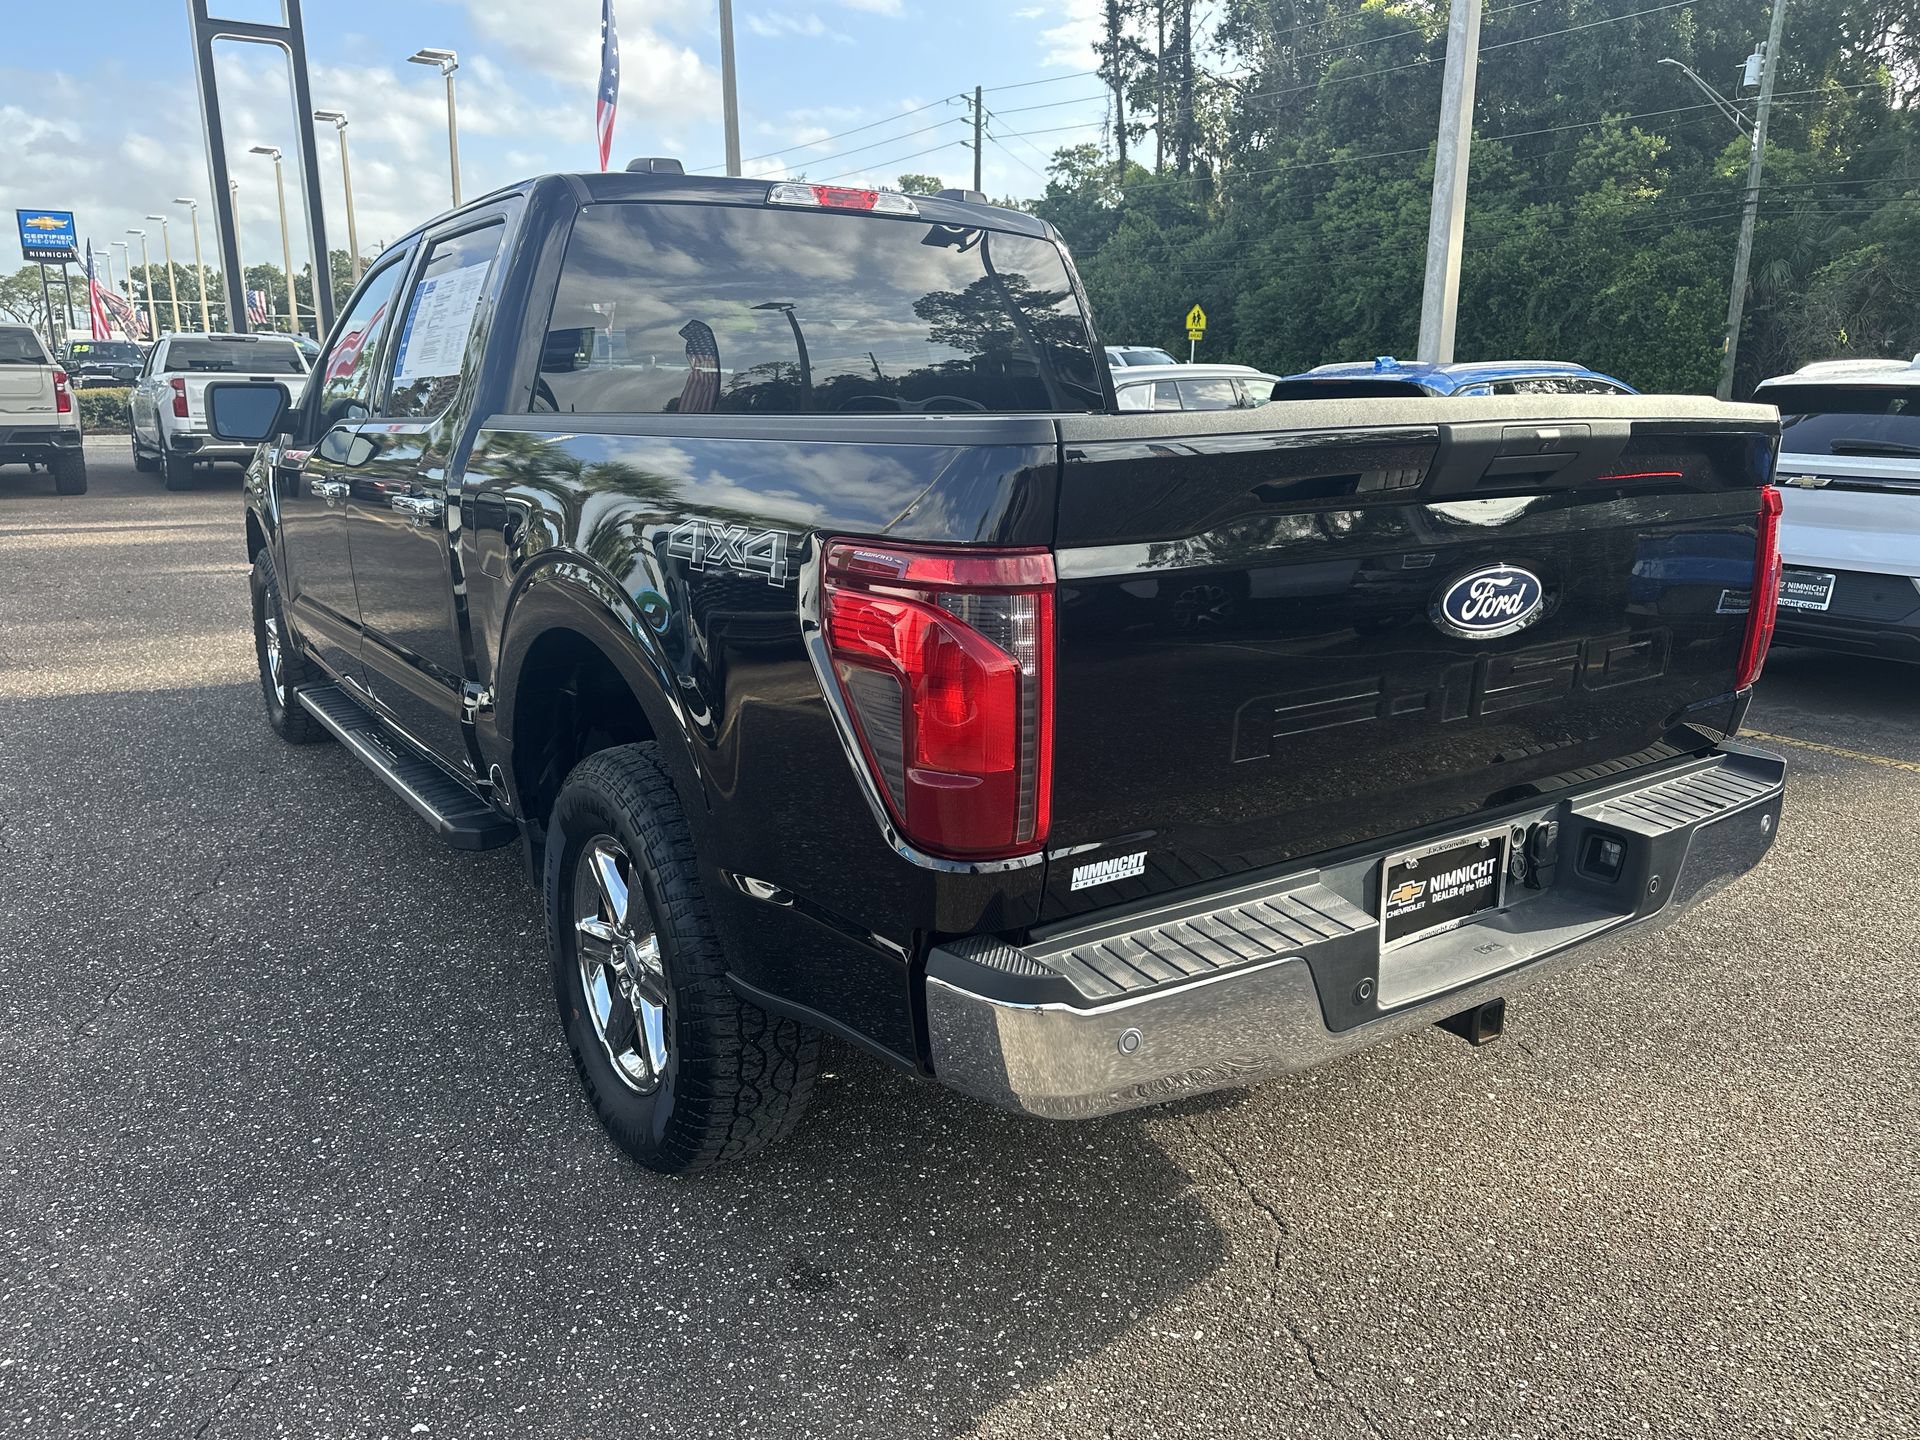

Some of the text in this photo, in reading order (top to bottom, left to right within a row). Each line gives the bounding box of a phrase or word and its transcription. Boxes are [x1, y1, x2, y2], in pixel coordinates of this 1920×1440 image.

[23, 233, 73, 241] CERTIFIED
[29, 250, 73, 258] NIMNICHT
[1461, 577, 1526, 621] Ford
[1787, 582, 1828, 593] NIMNICHT
[1230, 626, 1673, 764] F-150
[1072, 851, 1148, 882] NIMNICHT
[1074, 868, 1143, 888] CHEVROLET
[1430, 858, 1496, 893] NIMNICHT
[1432, 876, 1492, 903] DEALER of the YEAR
[1386, 901, 1426, 918] CHEVROLET
